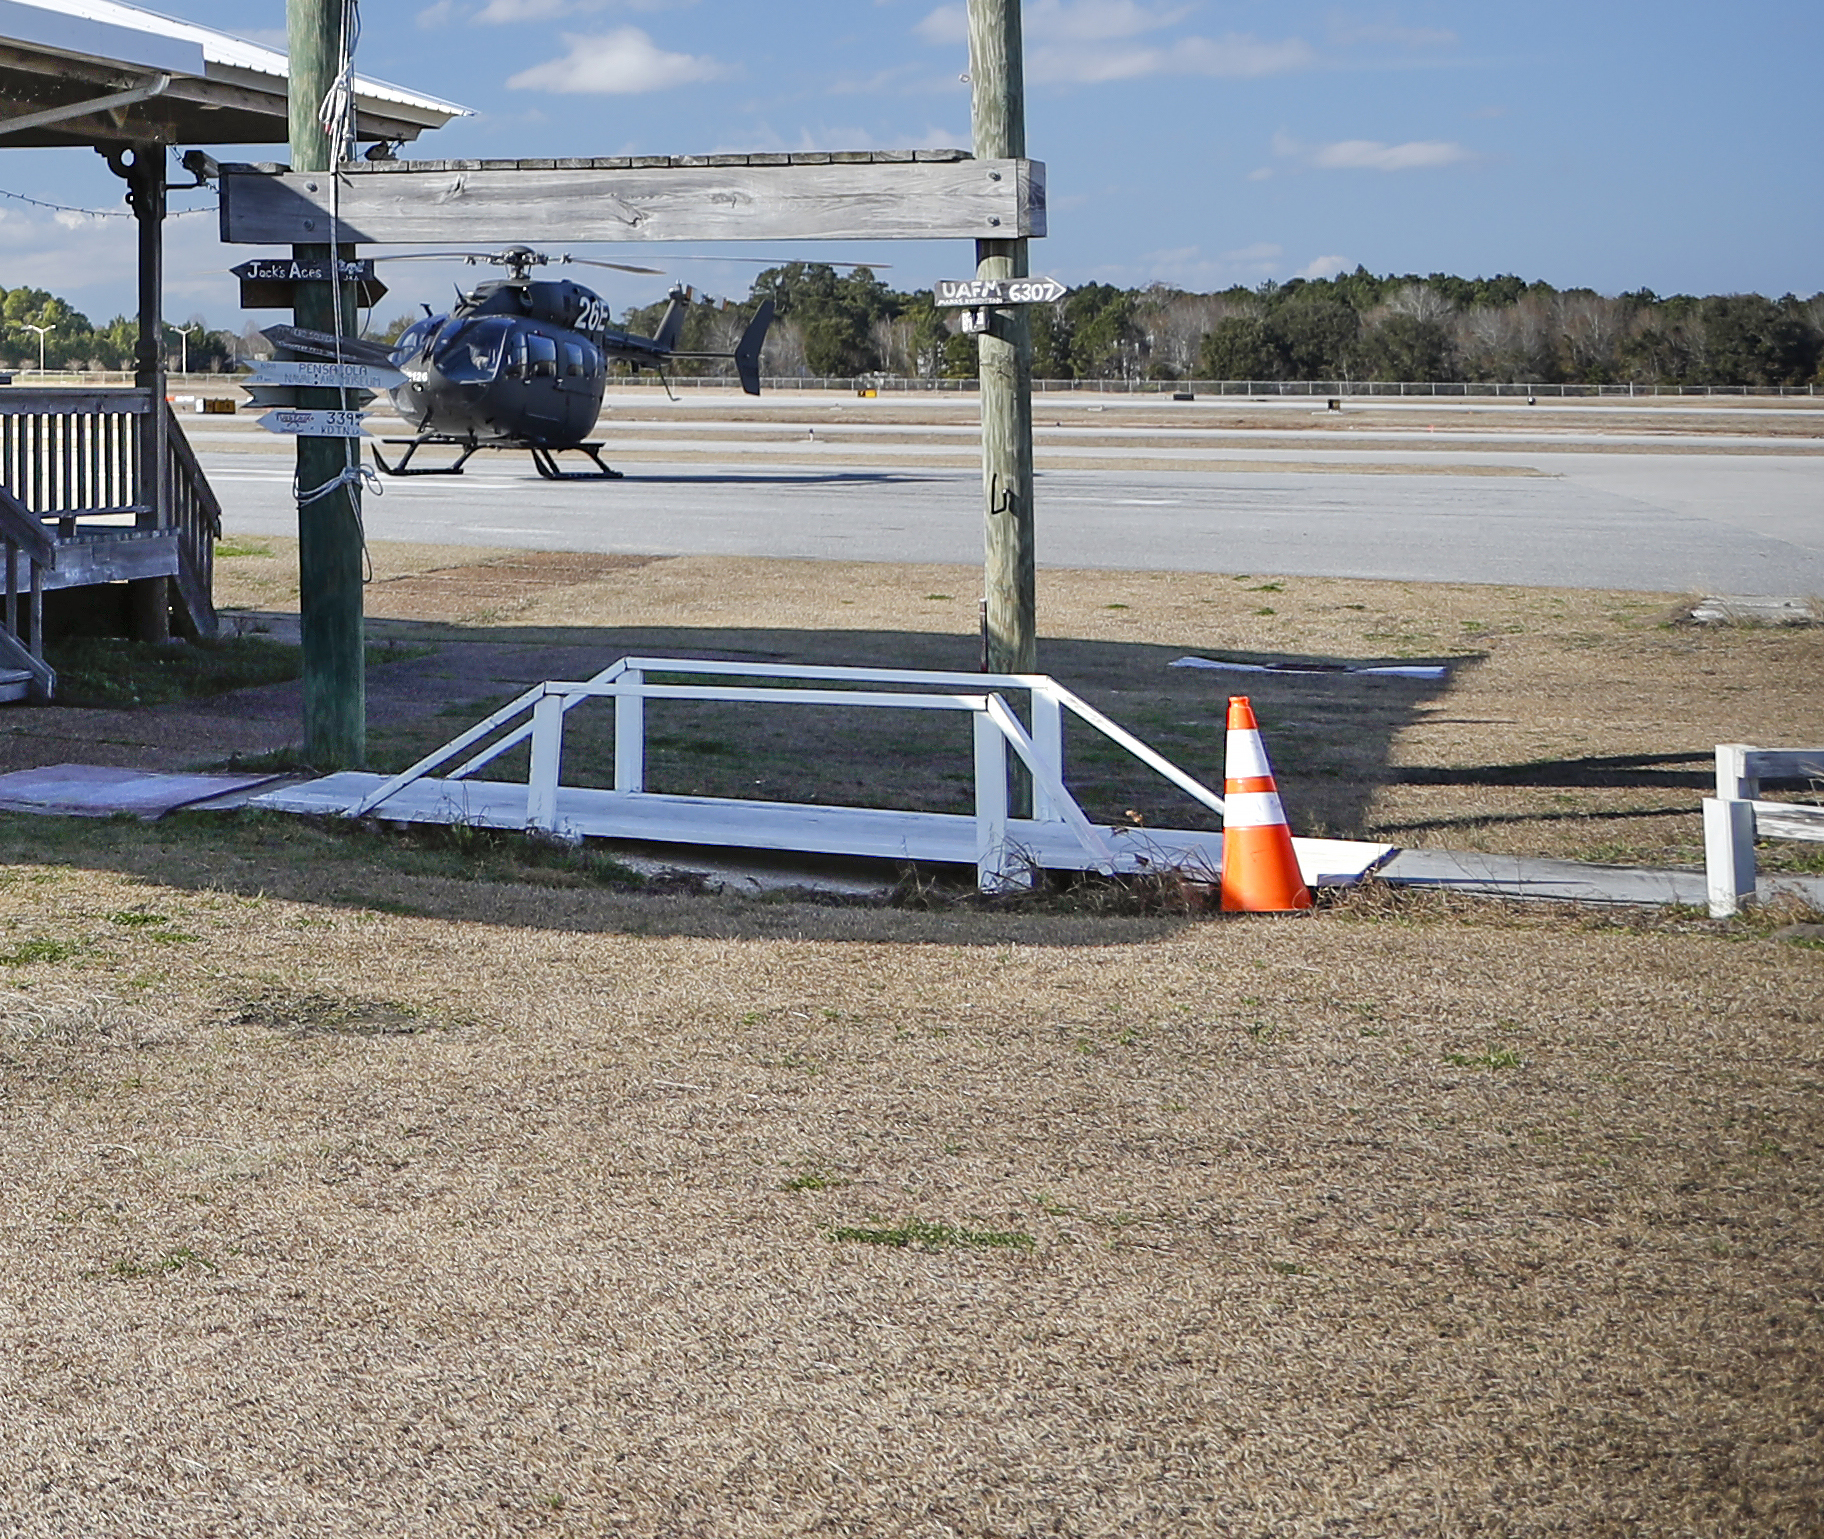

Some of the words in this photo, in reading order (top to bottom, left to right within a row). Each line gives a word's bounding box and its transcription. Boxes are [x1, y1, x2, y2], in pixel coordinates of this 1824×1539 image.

[247, 262, 286, 279] Jack's
[288, 261, 322, 279] Aces
[941, 280, 1002, 299] UAFM
[1009, 283, 1054, 302] 6307
[298, 362, 368, 376] PENSAOLA
[326, 411, 354, 426] 339
